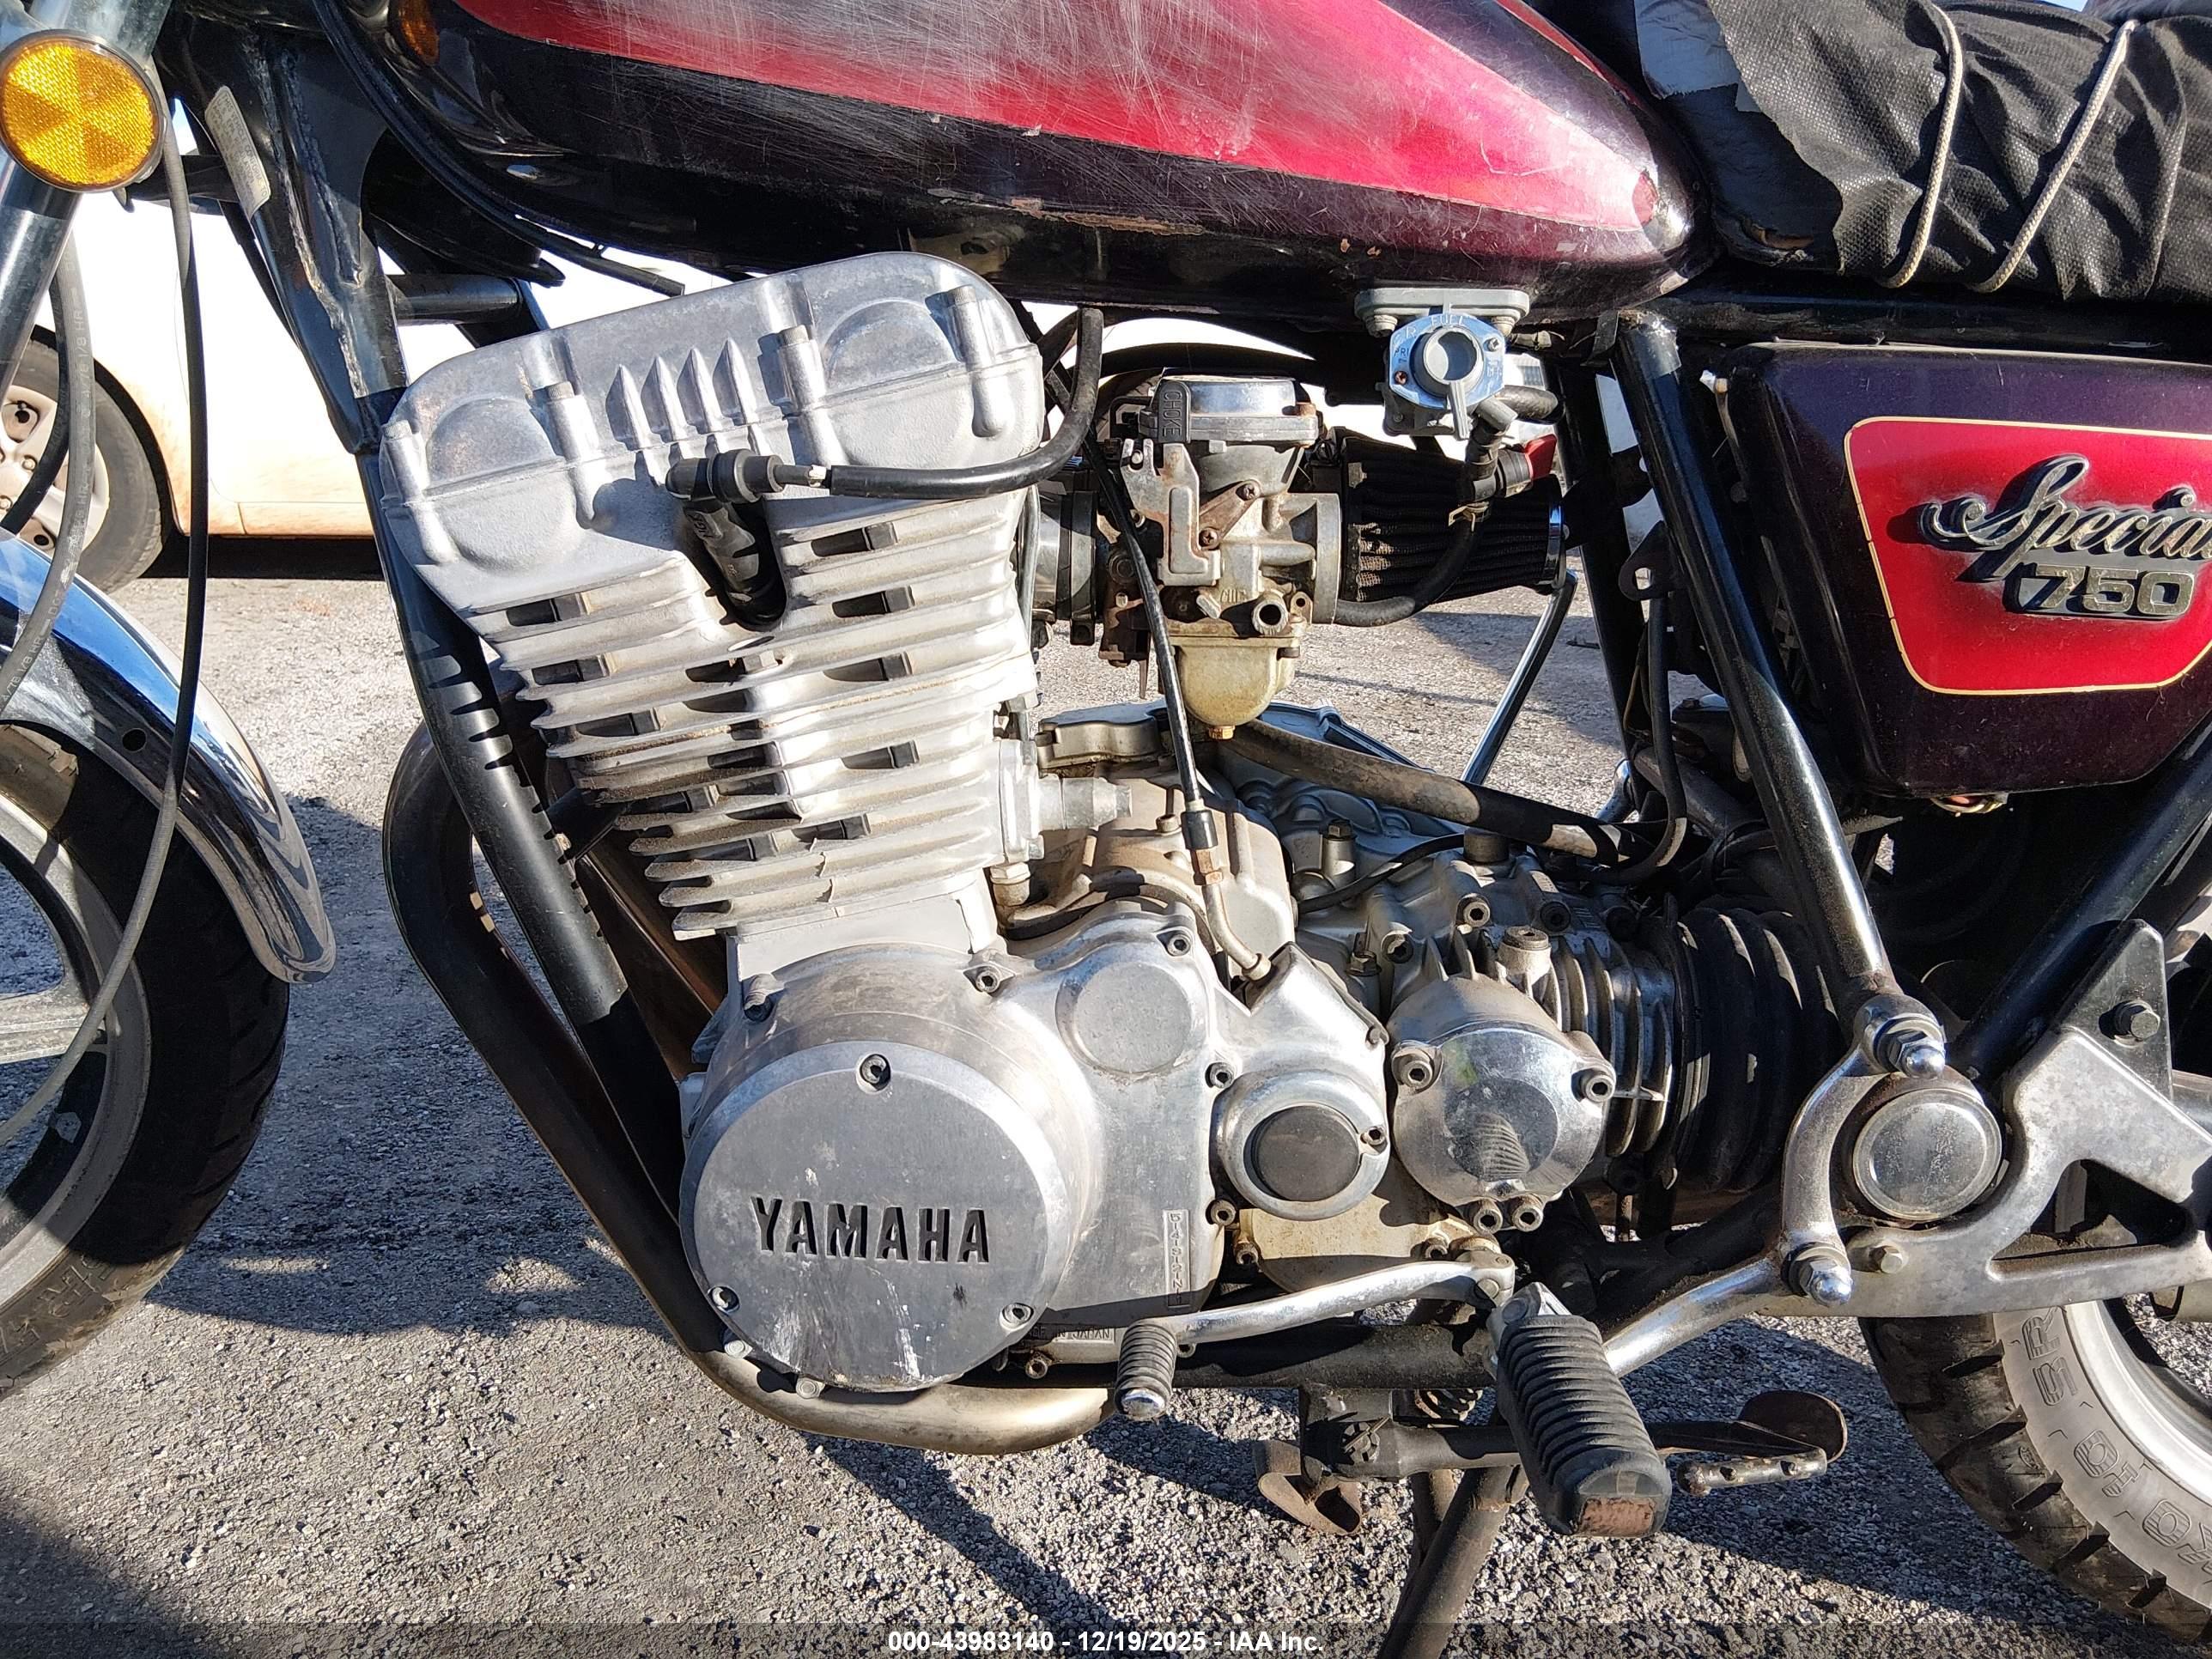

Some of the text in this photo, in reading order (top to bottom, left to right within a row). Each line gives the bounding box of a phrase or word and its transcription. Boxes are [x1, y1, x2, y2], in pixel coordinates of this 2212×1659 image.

[1162, 391, 1183, 437] CHOKE
[2035, 563, 2197, 616] 750
[750, 1195, 990, 1264] YAMAHA
